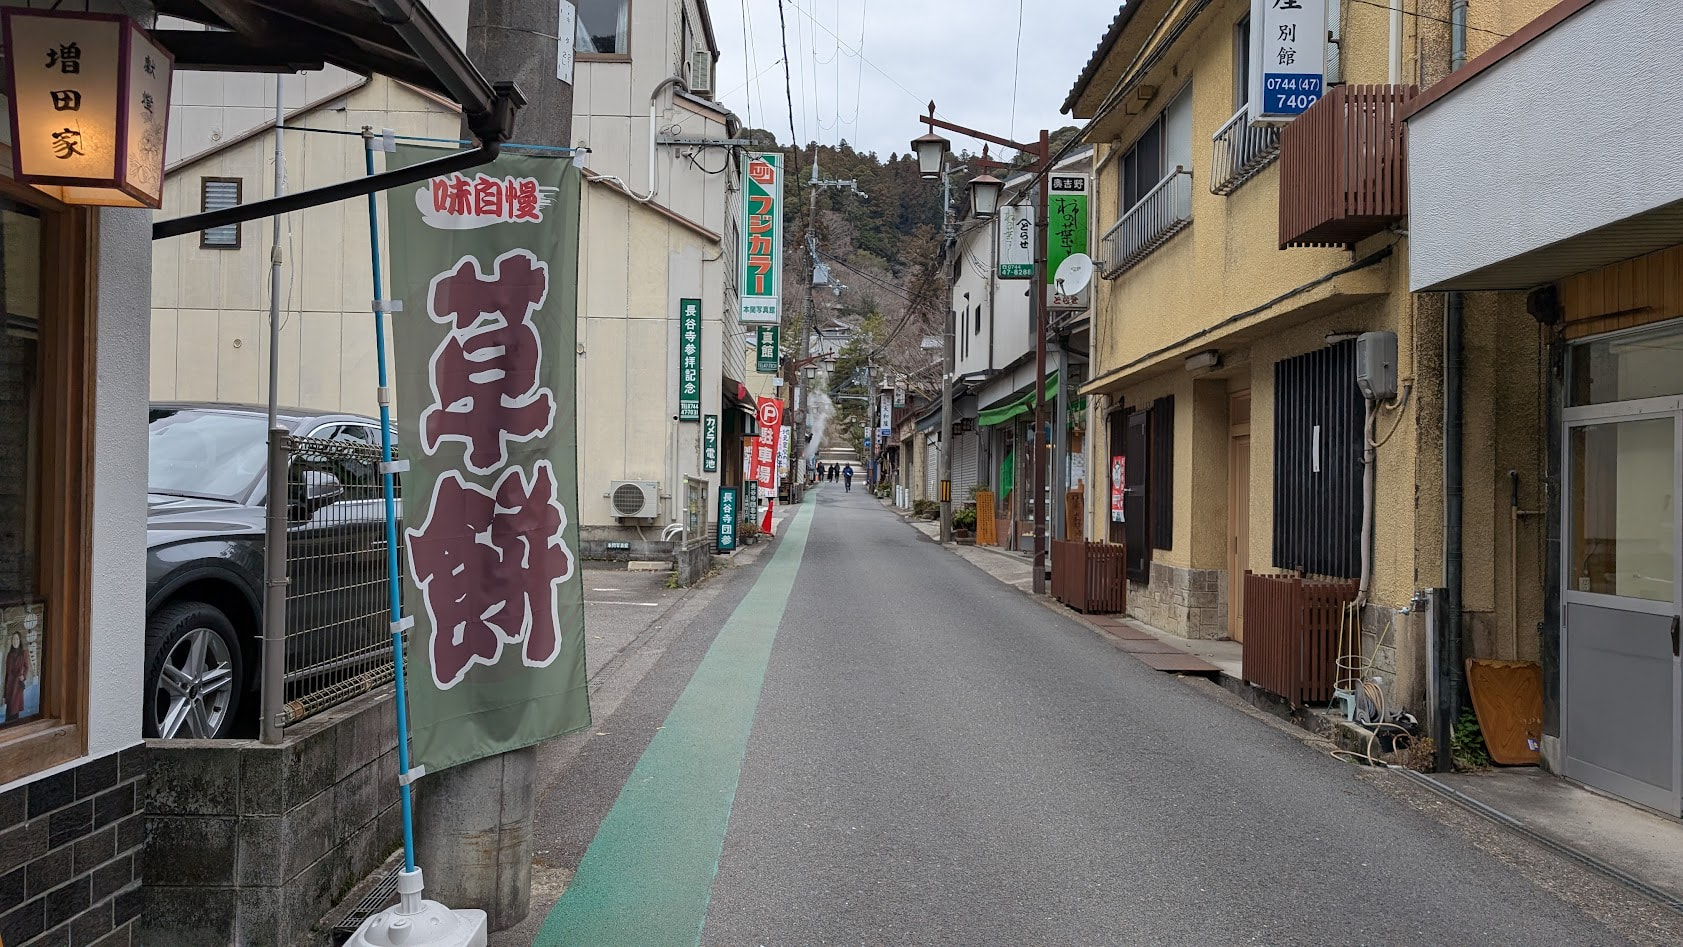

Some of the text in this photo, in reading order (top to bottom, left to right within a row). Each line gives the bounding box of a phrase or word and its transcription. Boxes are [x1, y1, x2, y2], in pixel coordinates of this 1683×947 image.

[45, 42, 84, 159] 増田家
[432, 175, 540, 220] 味自慢
[749, 195, 773, 294] フジカラー
[684, 304, 697, 394] 長谷寺参拝記念
[763, 406, 776, 421] P
[405, 249, 574, 690] 草餅
[756, 427, 774, 484] 駐車場
[721, 492, 734, 546] 長谷寺団参
